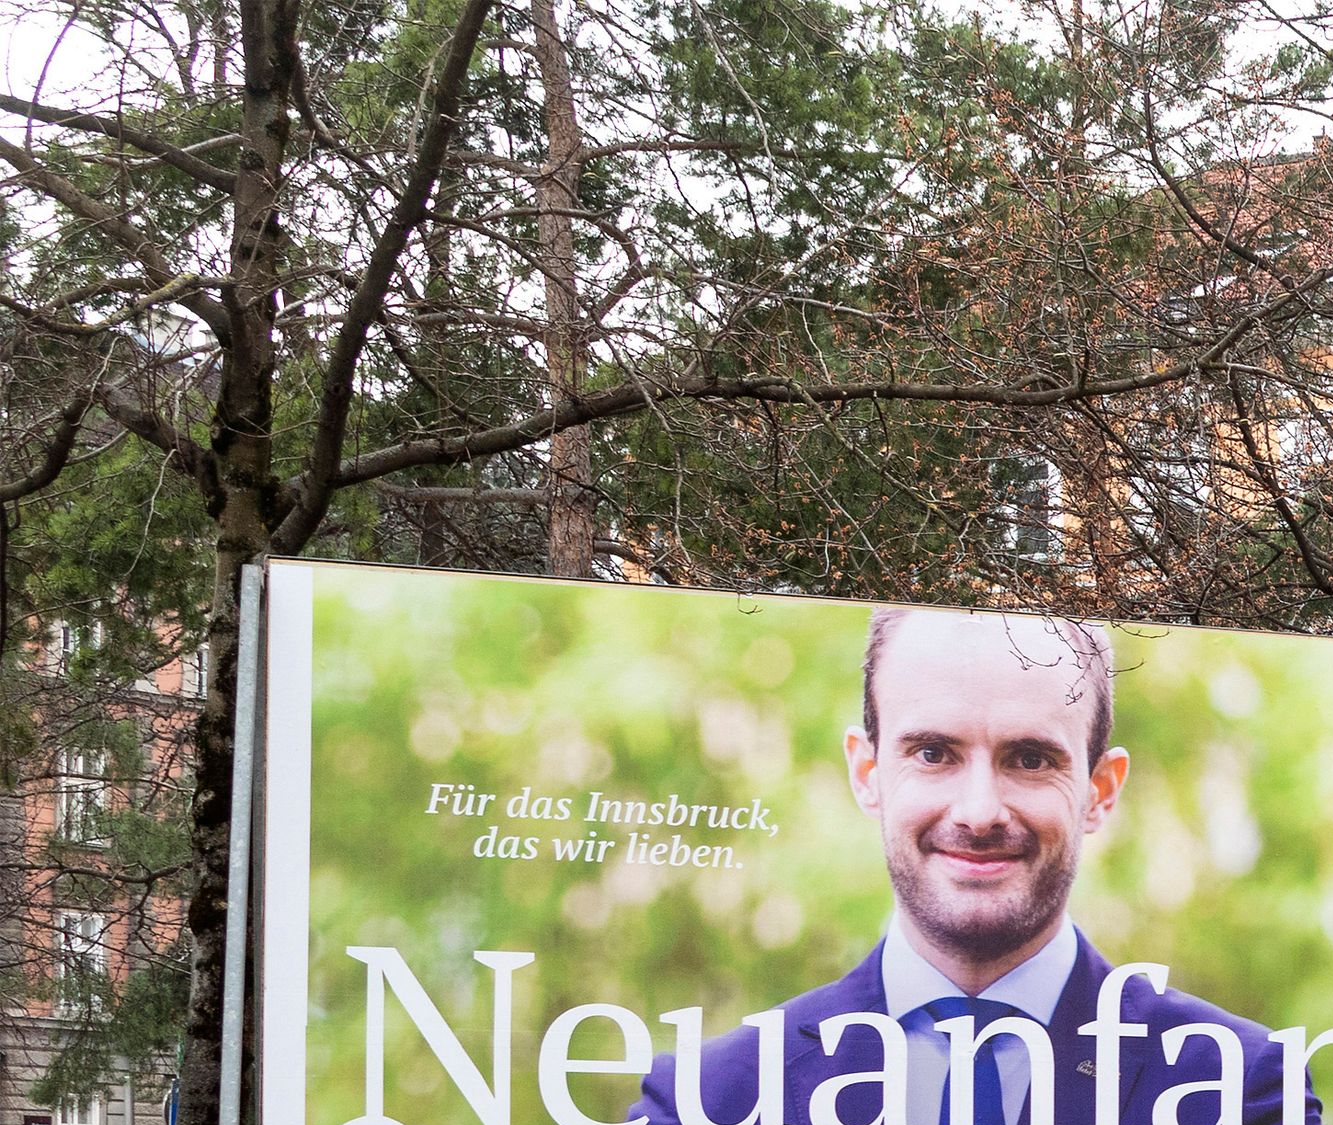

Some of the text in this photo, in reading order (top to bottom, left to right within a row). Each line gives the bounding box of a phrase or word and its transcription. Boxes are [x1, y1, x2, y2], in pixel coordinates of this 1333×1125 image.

[424, 783, 780, 838] Für das Innsbruck,
[473, 826, 744, 870] das wir lieben.
